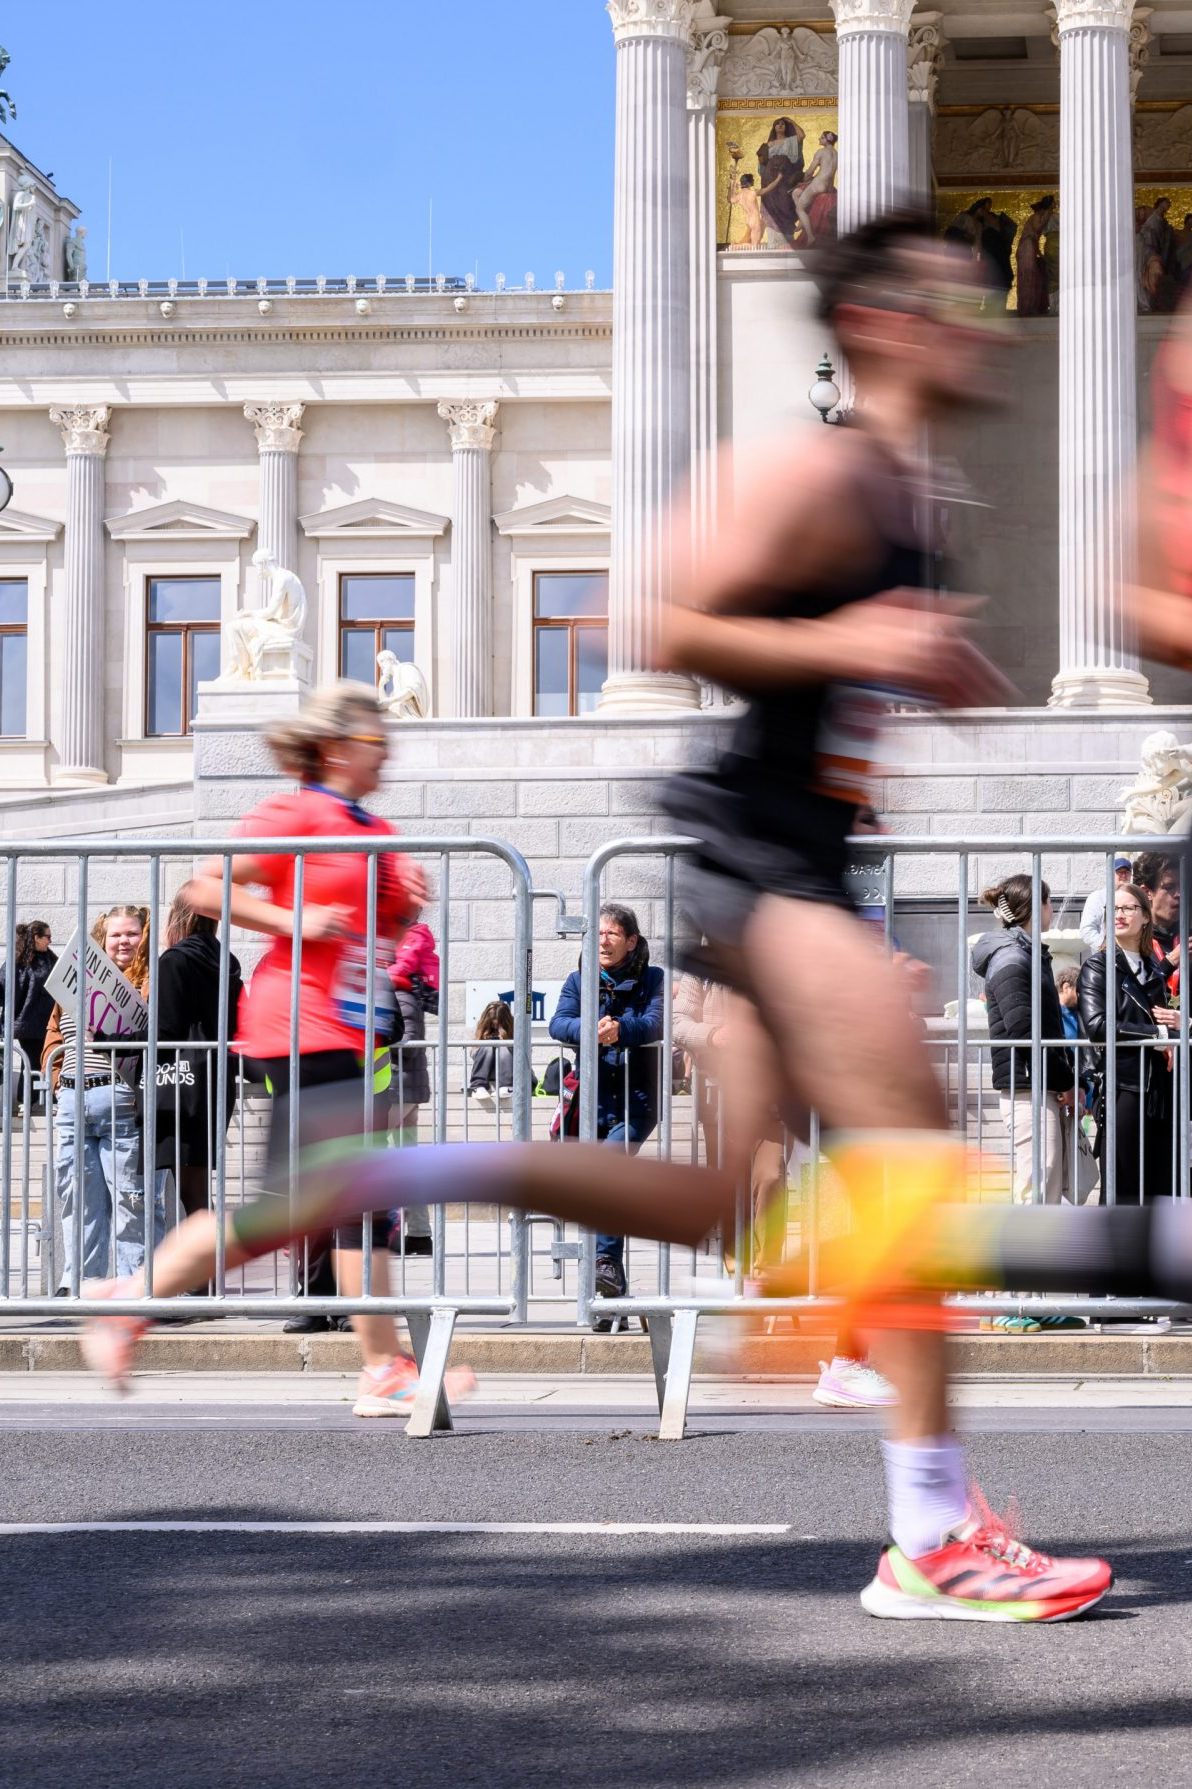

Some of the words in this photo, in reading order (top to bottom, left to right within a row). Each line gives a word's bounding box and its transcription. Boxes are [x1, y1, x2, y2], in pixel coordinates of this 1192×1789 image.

[98, 966, 113, 985] IF
[111, 978, 132, 1009] YOU
[131, 1001, 149, 1031] THI
[138, 1072, 195, 1090] SUNDS
